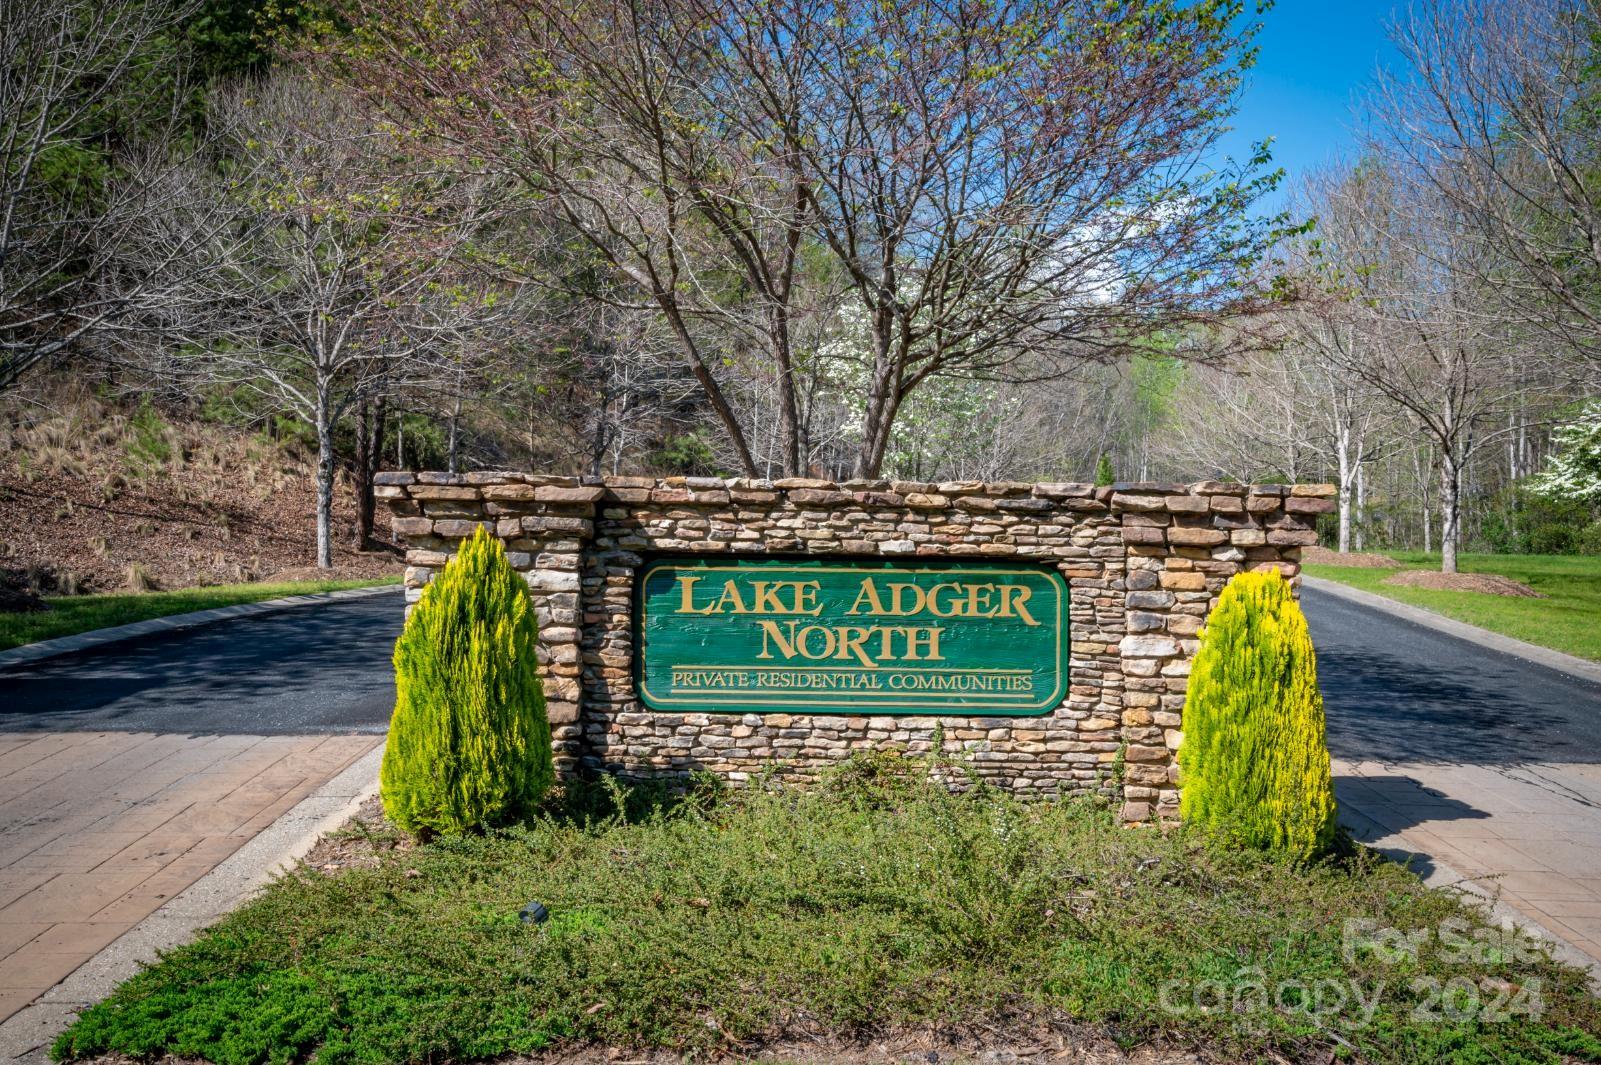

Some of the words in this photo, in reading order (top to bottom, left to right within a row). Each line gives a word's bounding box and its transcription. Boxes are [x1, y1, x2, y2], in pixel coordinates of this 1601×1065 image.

[675, 576, 823, 617] LAKE
[845, 576, 1041, 626] ADGER
[756, 620, 946, 668] NORTH
[672, 671, 750, 688] PRIVATE
[756, 672, 883, 689] RESIDENTIAL
[889, 673, 1033, 691] COMMUNITIES
